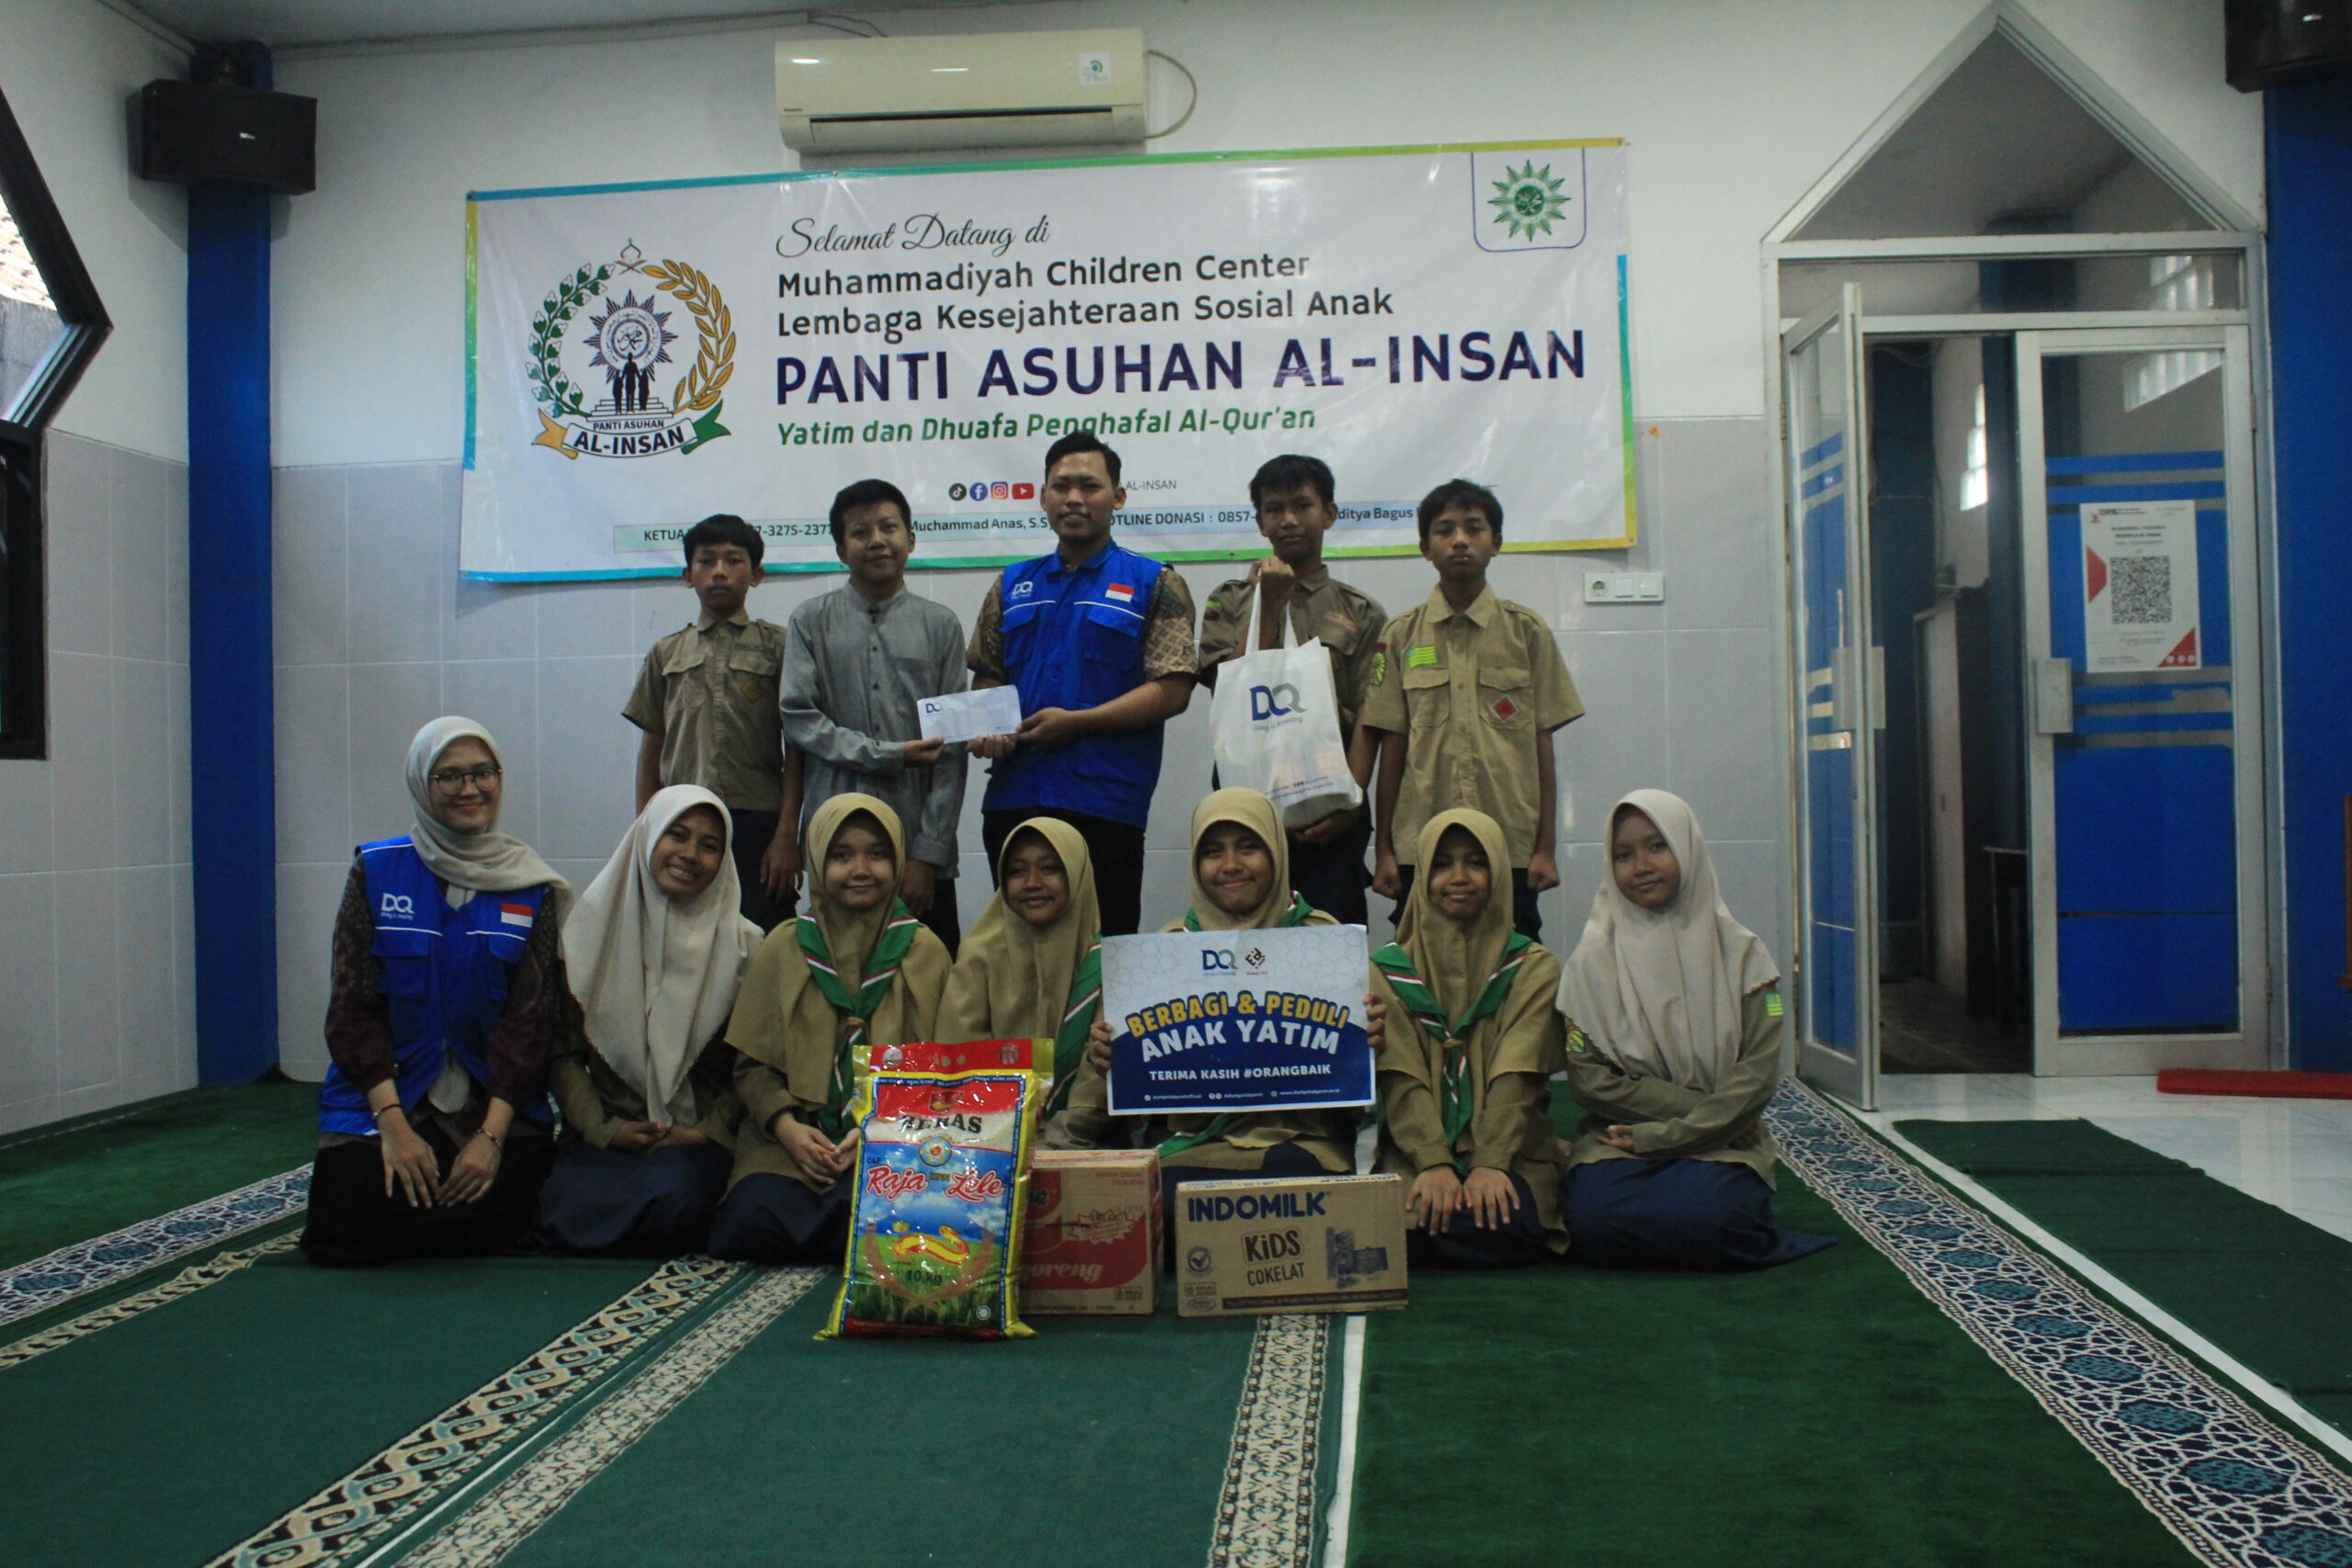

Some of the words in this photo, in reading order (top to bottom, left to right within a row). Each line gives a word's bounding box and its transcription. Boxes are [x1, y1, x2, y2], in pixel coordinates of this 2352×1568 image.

[776, 218, 896, 257] Selamat
[901, 213, 1016, 257] Datang
[1024, 215, 1050, 243] di
[778, 262, 1033, 298] Muhammadiyah
[1047, 256, 1182, 287] Children
[1196, 254, 1309, 281] Center
[778, 308, 922, 344] Lembaga
[937, 299, 1180, 333] Kesejahteraan
[1194, 289, 1293, 321] Sosial
[1306, 287, 1394, 317] Anak
[777, 351, 948, 405] PANTI
[977, 341, 1243, 398] ASUHAN
[1272, 329, 1585, 389] AL-INSAN
[573, 425, 684, 456] AL-INSAN
[593, 421, 622, 431] PANTI
[624, 419, 664, 429] ASUHAN
[778, 422, 854, 446] Yatim
[863, 421, 912, 444] dan
[922, 412, 1018, 441] Dhuafa
[1026, 408, 1170, 437] Penghafal
[1125, 479, 1177, 491] AL-INSAN
[644, 529, 684, 541] KETUA
[755, 524, 831, 536] 7-3275-237
[911, 518, 986, 531] Muchammad
[991, 517, 1026, 530] Anas,
[1029, 517, 1053, 530] S.S
[1155, 512, 1204, 525] DONASI
[1337, 508, 1371, 522] ditya
[1374, 507, 1413, 521] Bagus
[1250, 682, 1307, 721] DQ
[381, 892, 415, 914] DQ
[1201, 949, 1238, 971] DQ
[1125, 991, 1228, 1037] BERBAGI
[1238, 990, 1257, 1015] &
[1264, 991, 1351, 1030] PEDULI
[1141, 1021, 1227, 1062] ANAK
[1236, 1020, 1340, 1055] YATIM
[1149, 1070, 1197, 1081] TERIMA
[1201, 1068, 1239, 1080] KASIH
[1243, 1064, 1330, 1079] #ORANGBAIK
[866, 1165, 928, 1202] Raja
[944, 1170, 1004, 1203] Lele
[1188, 1191, 1326, 1223] INDOMILK
[906, 1269, 922, 1282] 10
[1247, 1262, 1305, 1287] COKELAT
